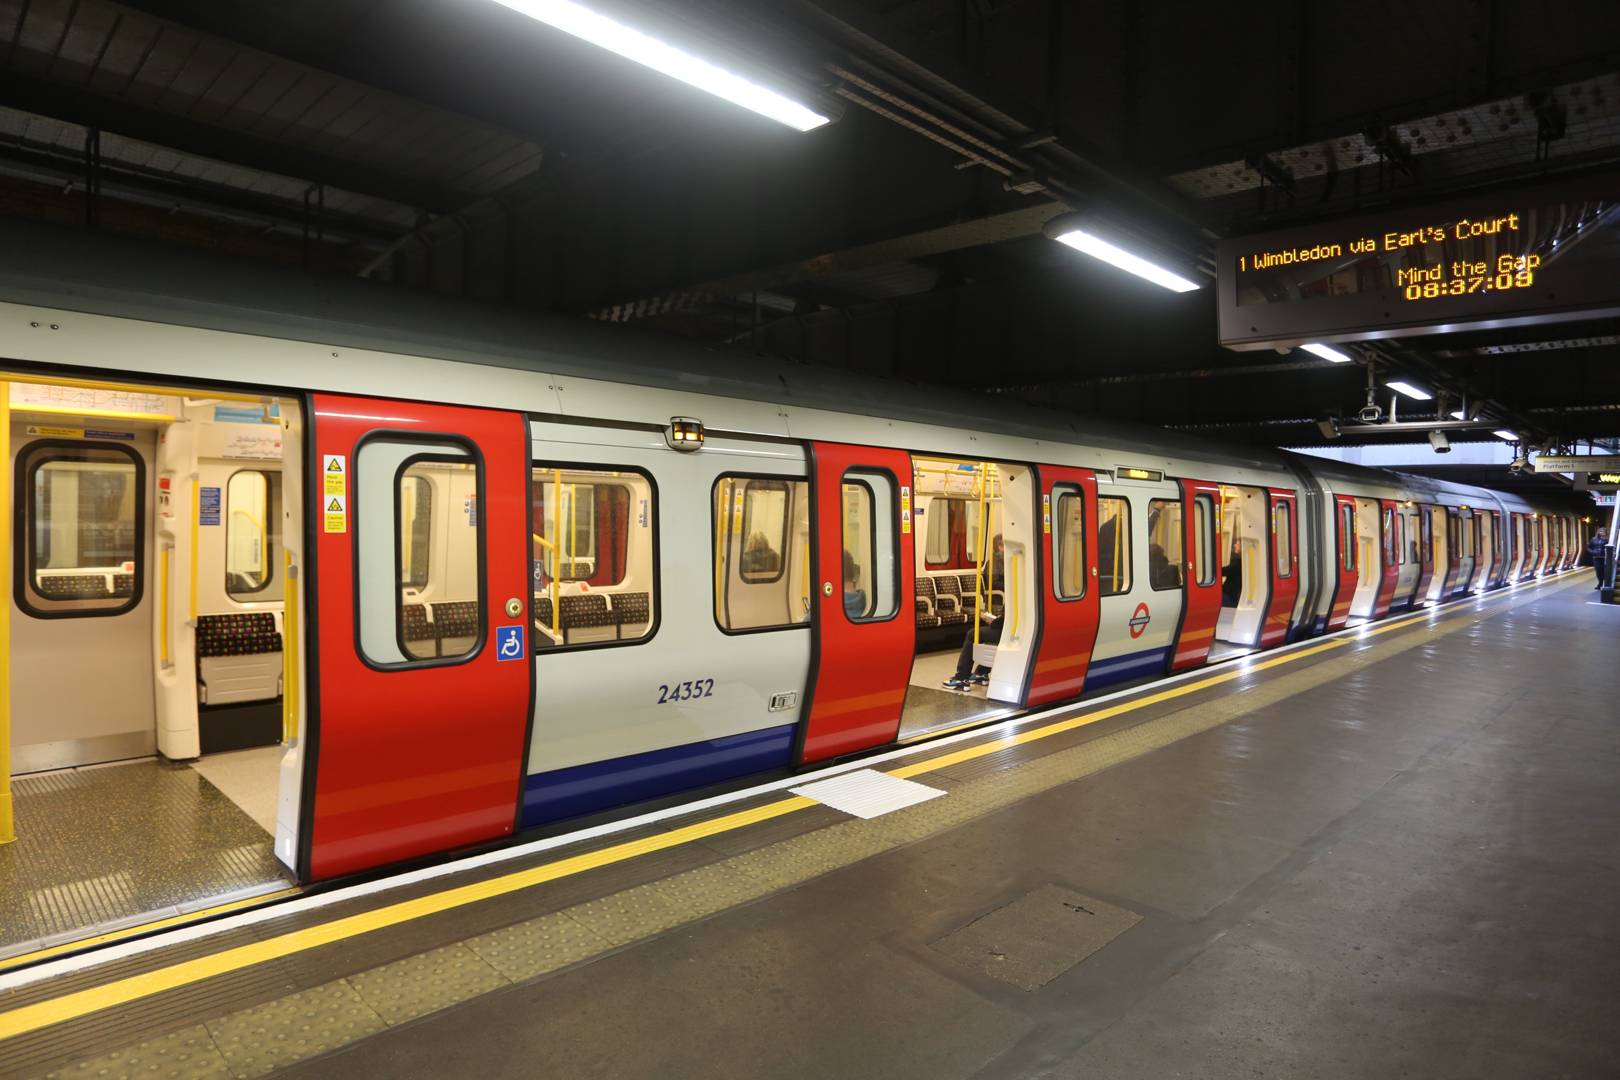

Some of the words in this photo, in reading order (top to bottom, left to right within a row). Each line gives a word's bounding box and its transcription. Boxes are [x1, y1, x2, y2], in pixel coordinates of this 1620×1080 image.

[1240, 256, 1246, 272] 1
[1253, 244, 1341, 269] Wimbledon
[1349, 238, 1376, 254] via
[1384, 227, 1446, 250] Earl's
[1456, 213, 1519, 239] Court
[1398, 264, 1442, 286] Mind
[1453, 261, 1487, 277] the
[1498, 254, 1540, 273] Gap
[657, 678, 714, 704] 24352
